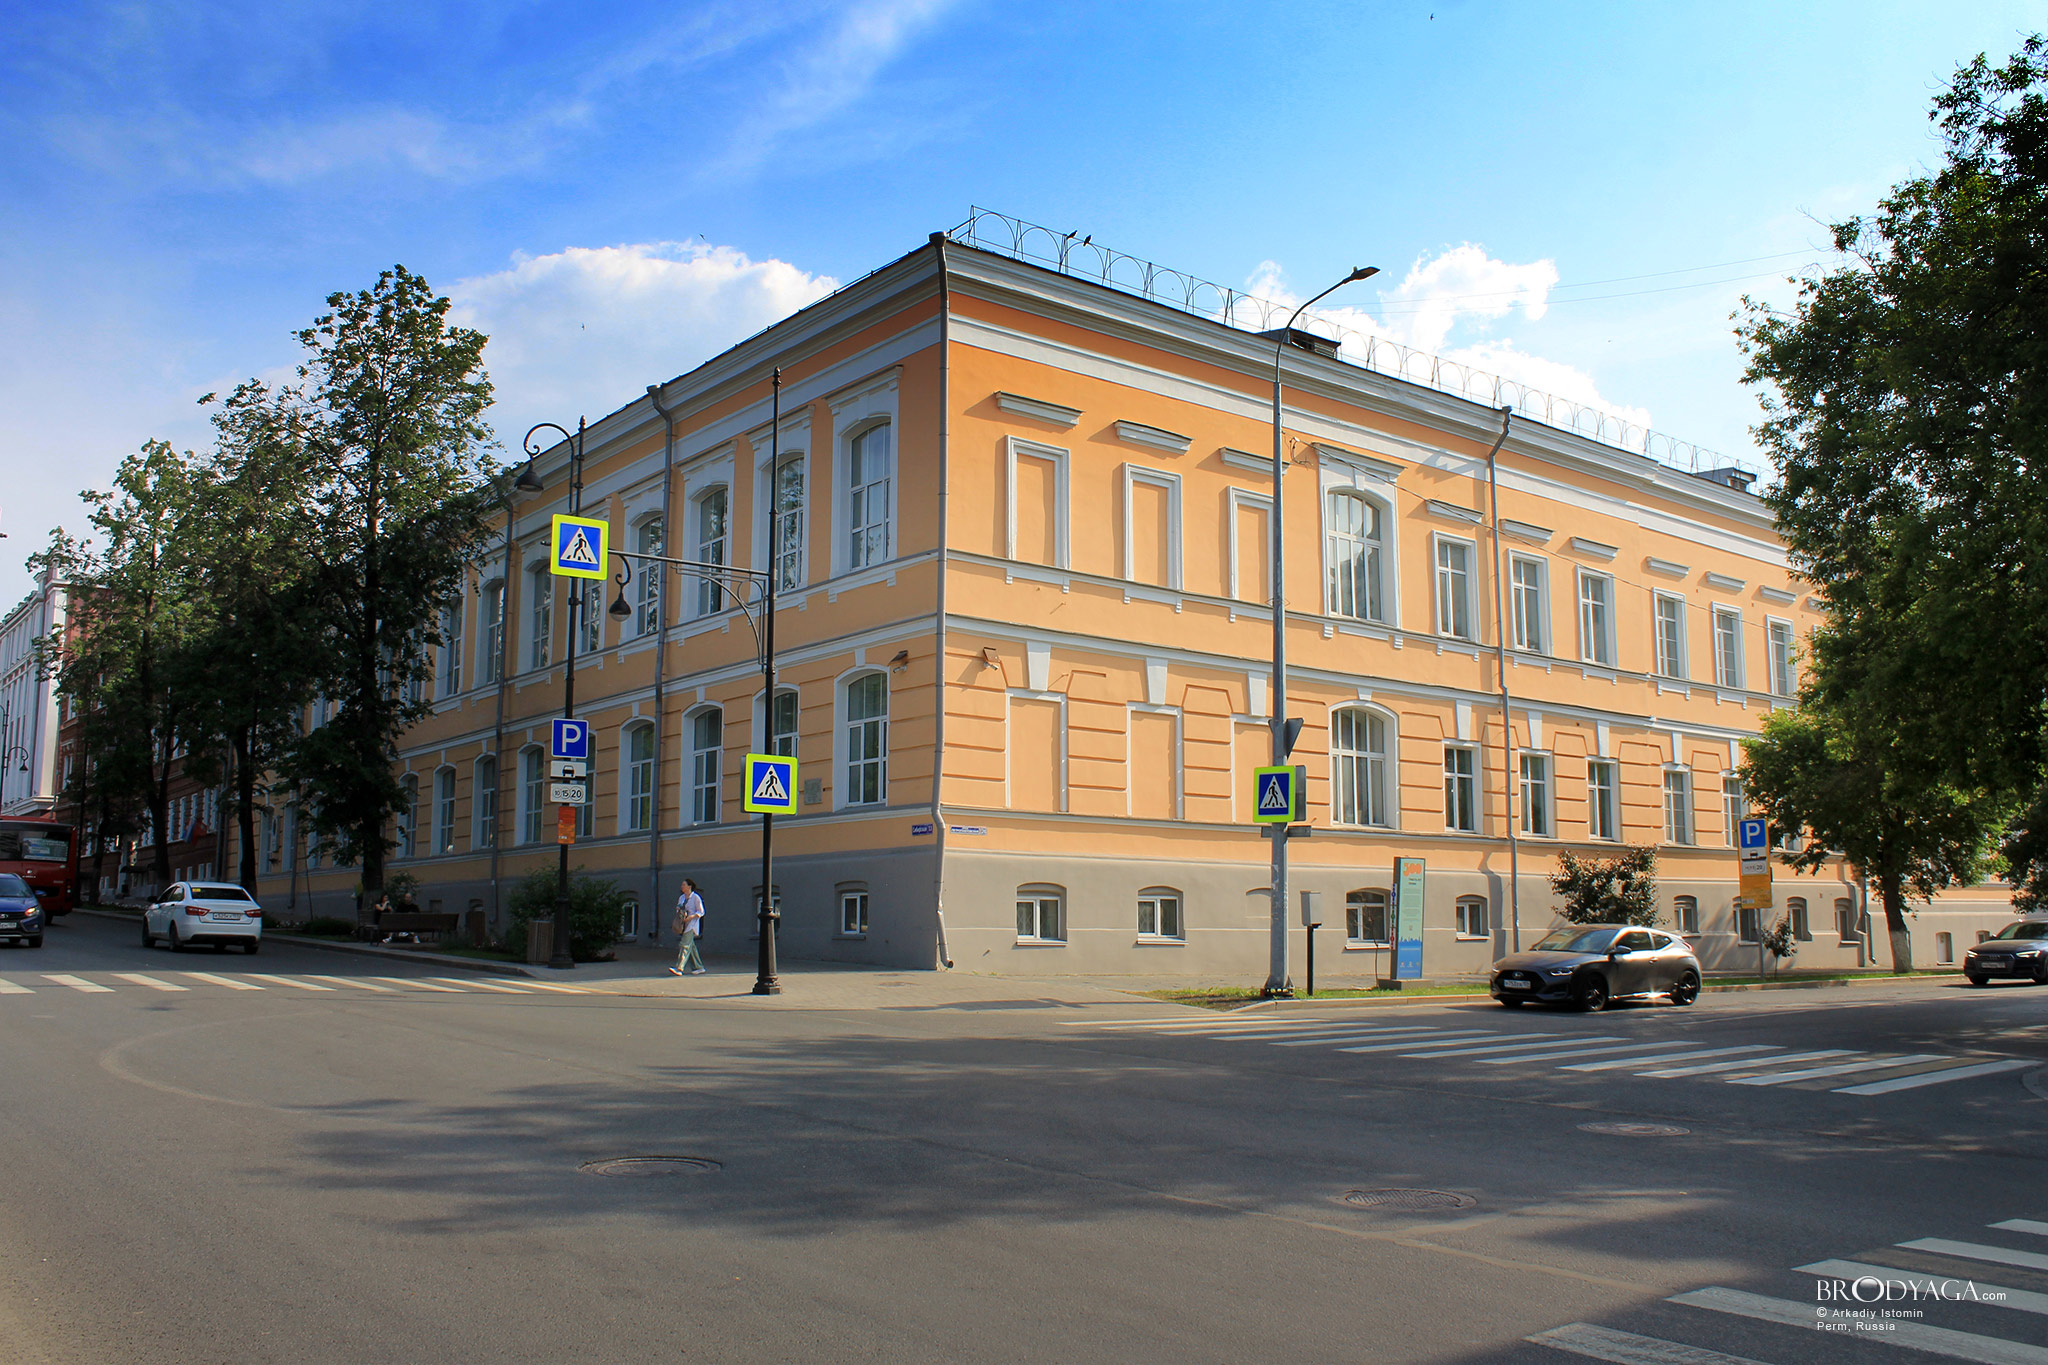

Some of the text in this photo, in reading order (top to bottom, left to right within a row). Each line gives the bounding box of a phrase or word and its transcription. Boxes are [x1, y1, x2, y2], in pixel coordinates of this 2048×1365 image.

[561, 723, 582, 753] P
[562, 789, 569, 797] 15
[571, 789, 582, 798] 20
[1745, 822, 1761, 845] P
